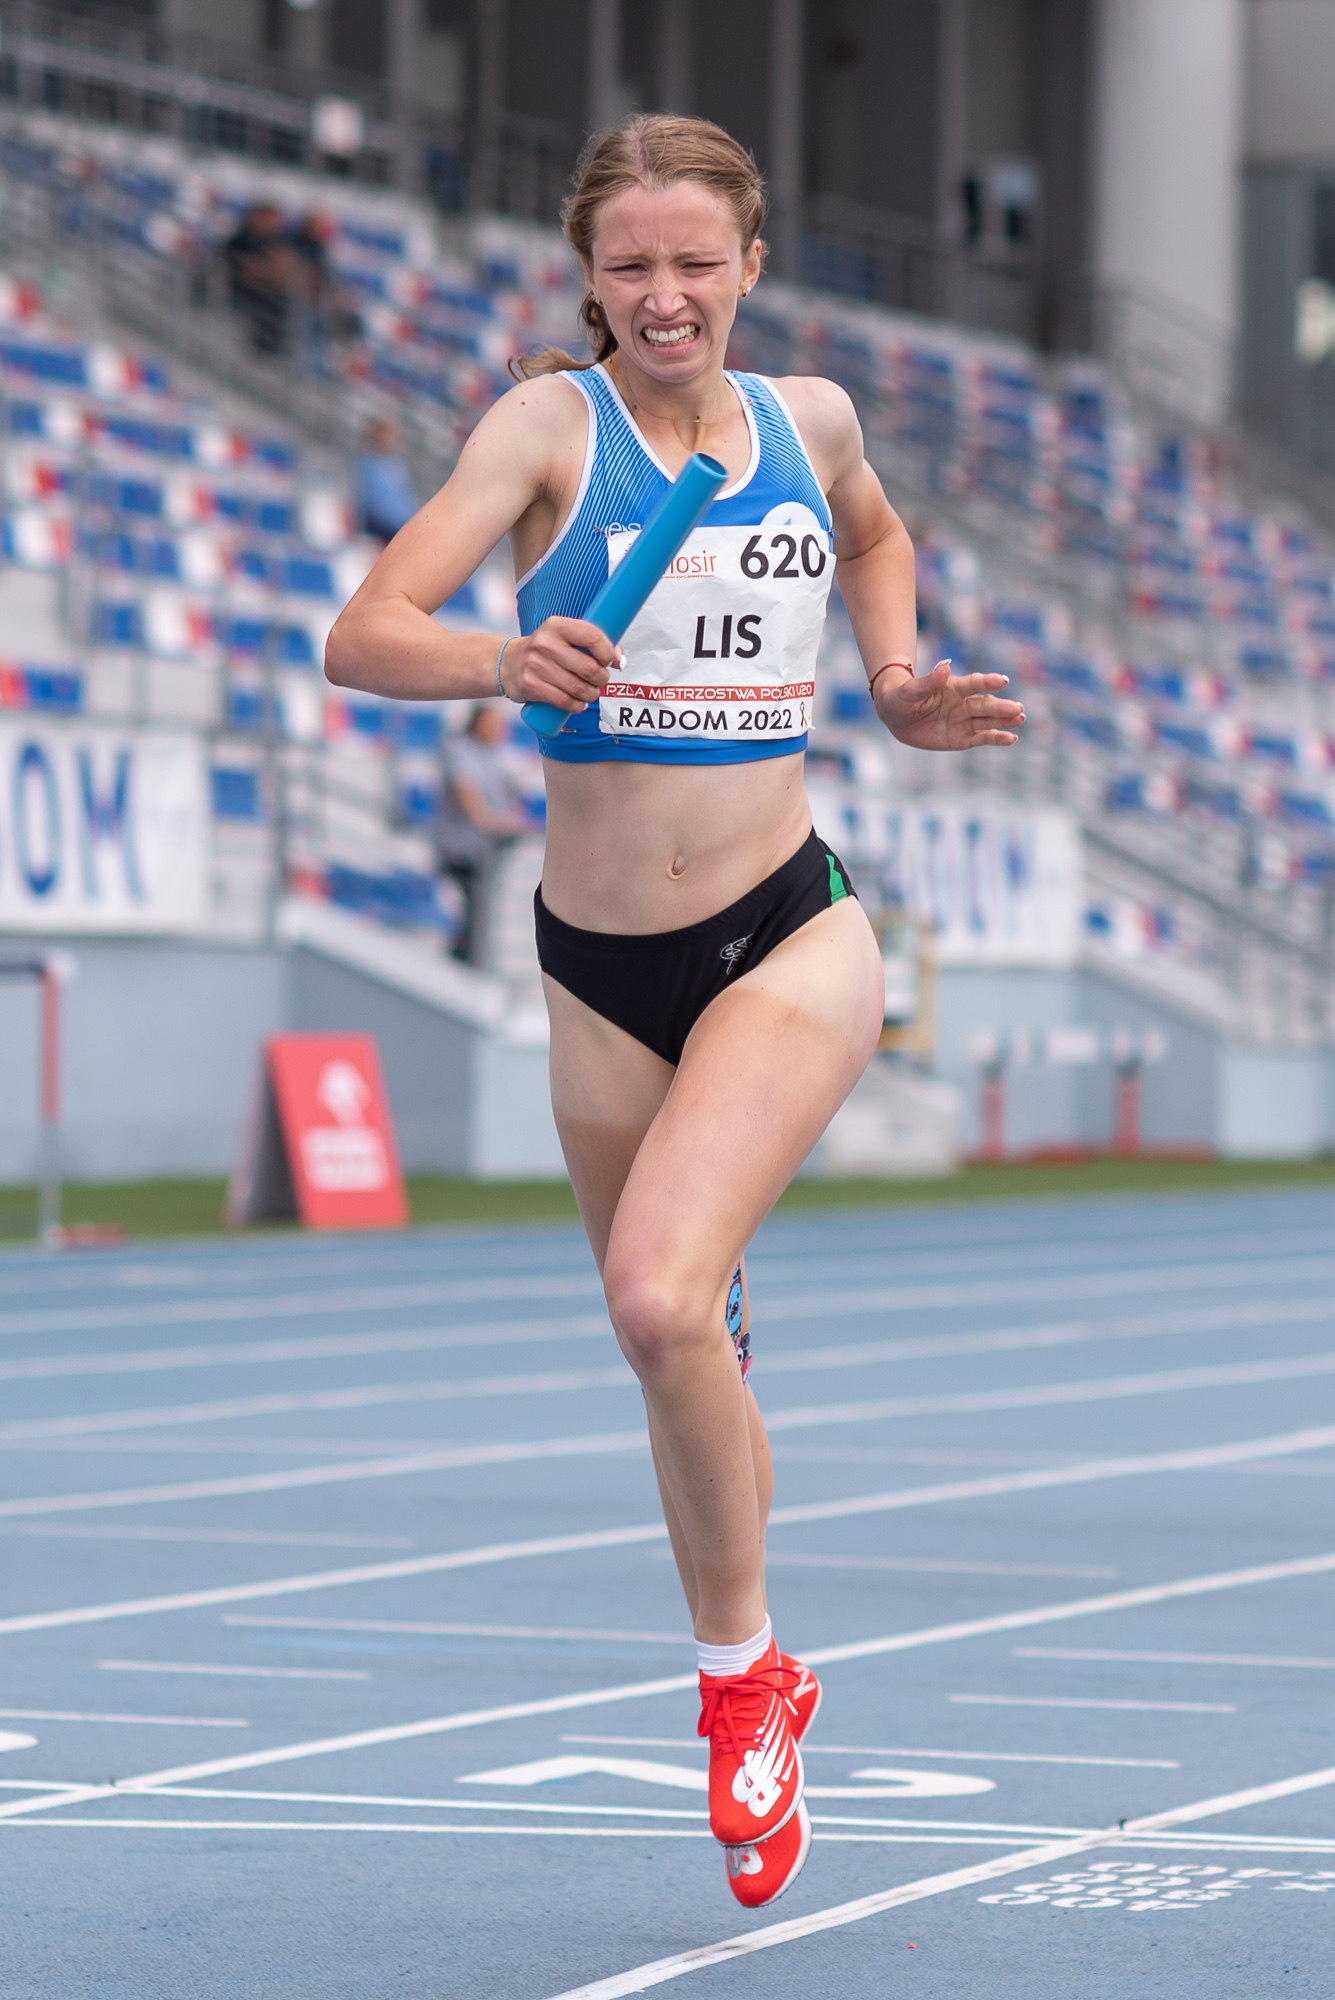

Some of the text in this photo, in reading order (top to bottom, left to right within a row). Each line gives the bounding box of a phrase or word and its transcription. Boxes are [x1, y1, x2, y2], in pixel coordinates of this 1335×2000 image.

[740, 533, 826, 579] 620
[694, 614, 762, 659] LIS
[606, 684, 646, 698] PZLA
[649, 686, 756, 700] MISTRZOSTWA
[618, 706, 793, 731] RADOM 2022
